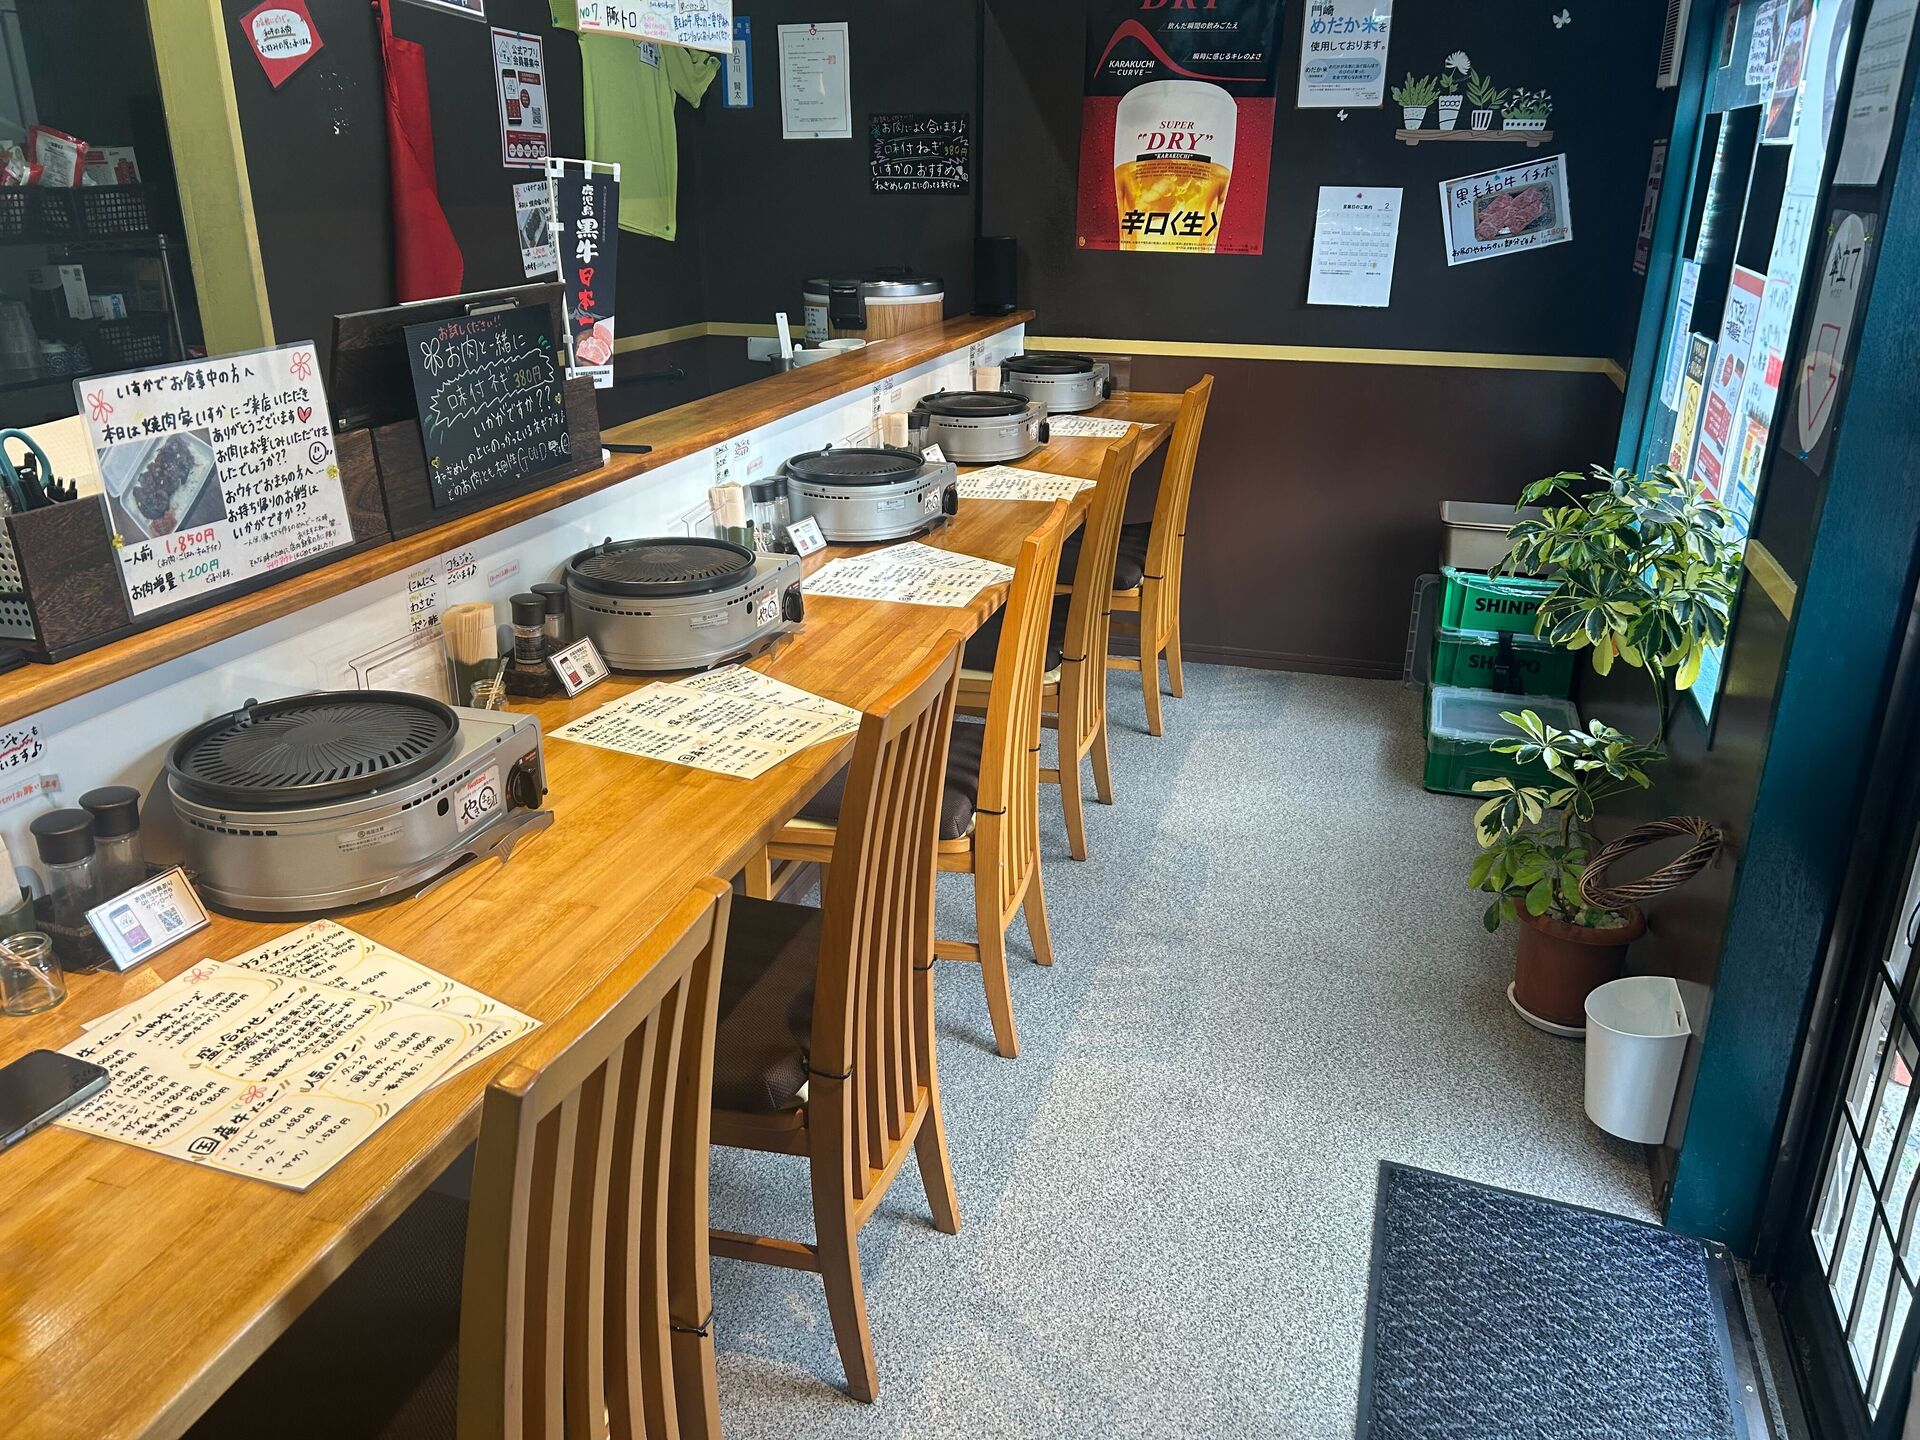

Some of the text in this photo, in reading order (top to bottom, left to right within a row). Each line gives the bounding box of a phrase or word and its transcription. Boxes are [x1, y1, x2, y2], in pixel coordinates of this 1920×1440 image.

[606, 5, 637, 30] 豚トロ
[1167, 22, 1239, 30] 飲んだ瞬間の飲みごたえ
[511, 45, 538, 58] 公式アプリ
[1310, 40, 1385, 52] 使用しております。
[513, 56, 540, 69] 会員募集中
[1108, 60, 1155, 69] KARAKUCHI
[1192, 52, 1262, 61] 瞬時に感じるキレのよさ
[1159, 120, 1195, 130] SUPER
[513, 365, 542, 389] 380円
[124, 527, 215, 566] 一人前 1,850円
[131, 571, 178, 601] お肉増量
[410, 592, 436, 612] わさび
[1475, 597, 1540, 616] SHINP
[371, 1031, 400, 1049] 680円
[184, 1080, 218, 1101] 880円
[198, 1086, 231, 1106] 980円
[224, 1105, 294, 1153] カルビ 980円
[243, 1106, 317, 1159] ハラミ 1,680円
[312, 1117, 352, 1144] 1,580円
[264, 1149, 287, 1164] タン
